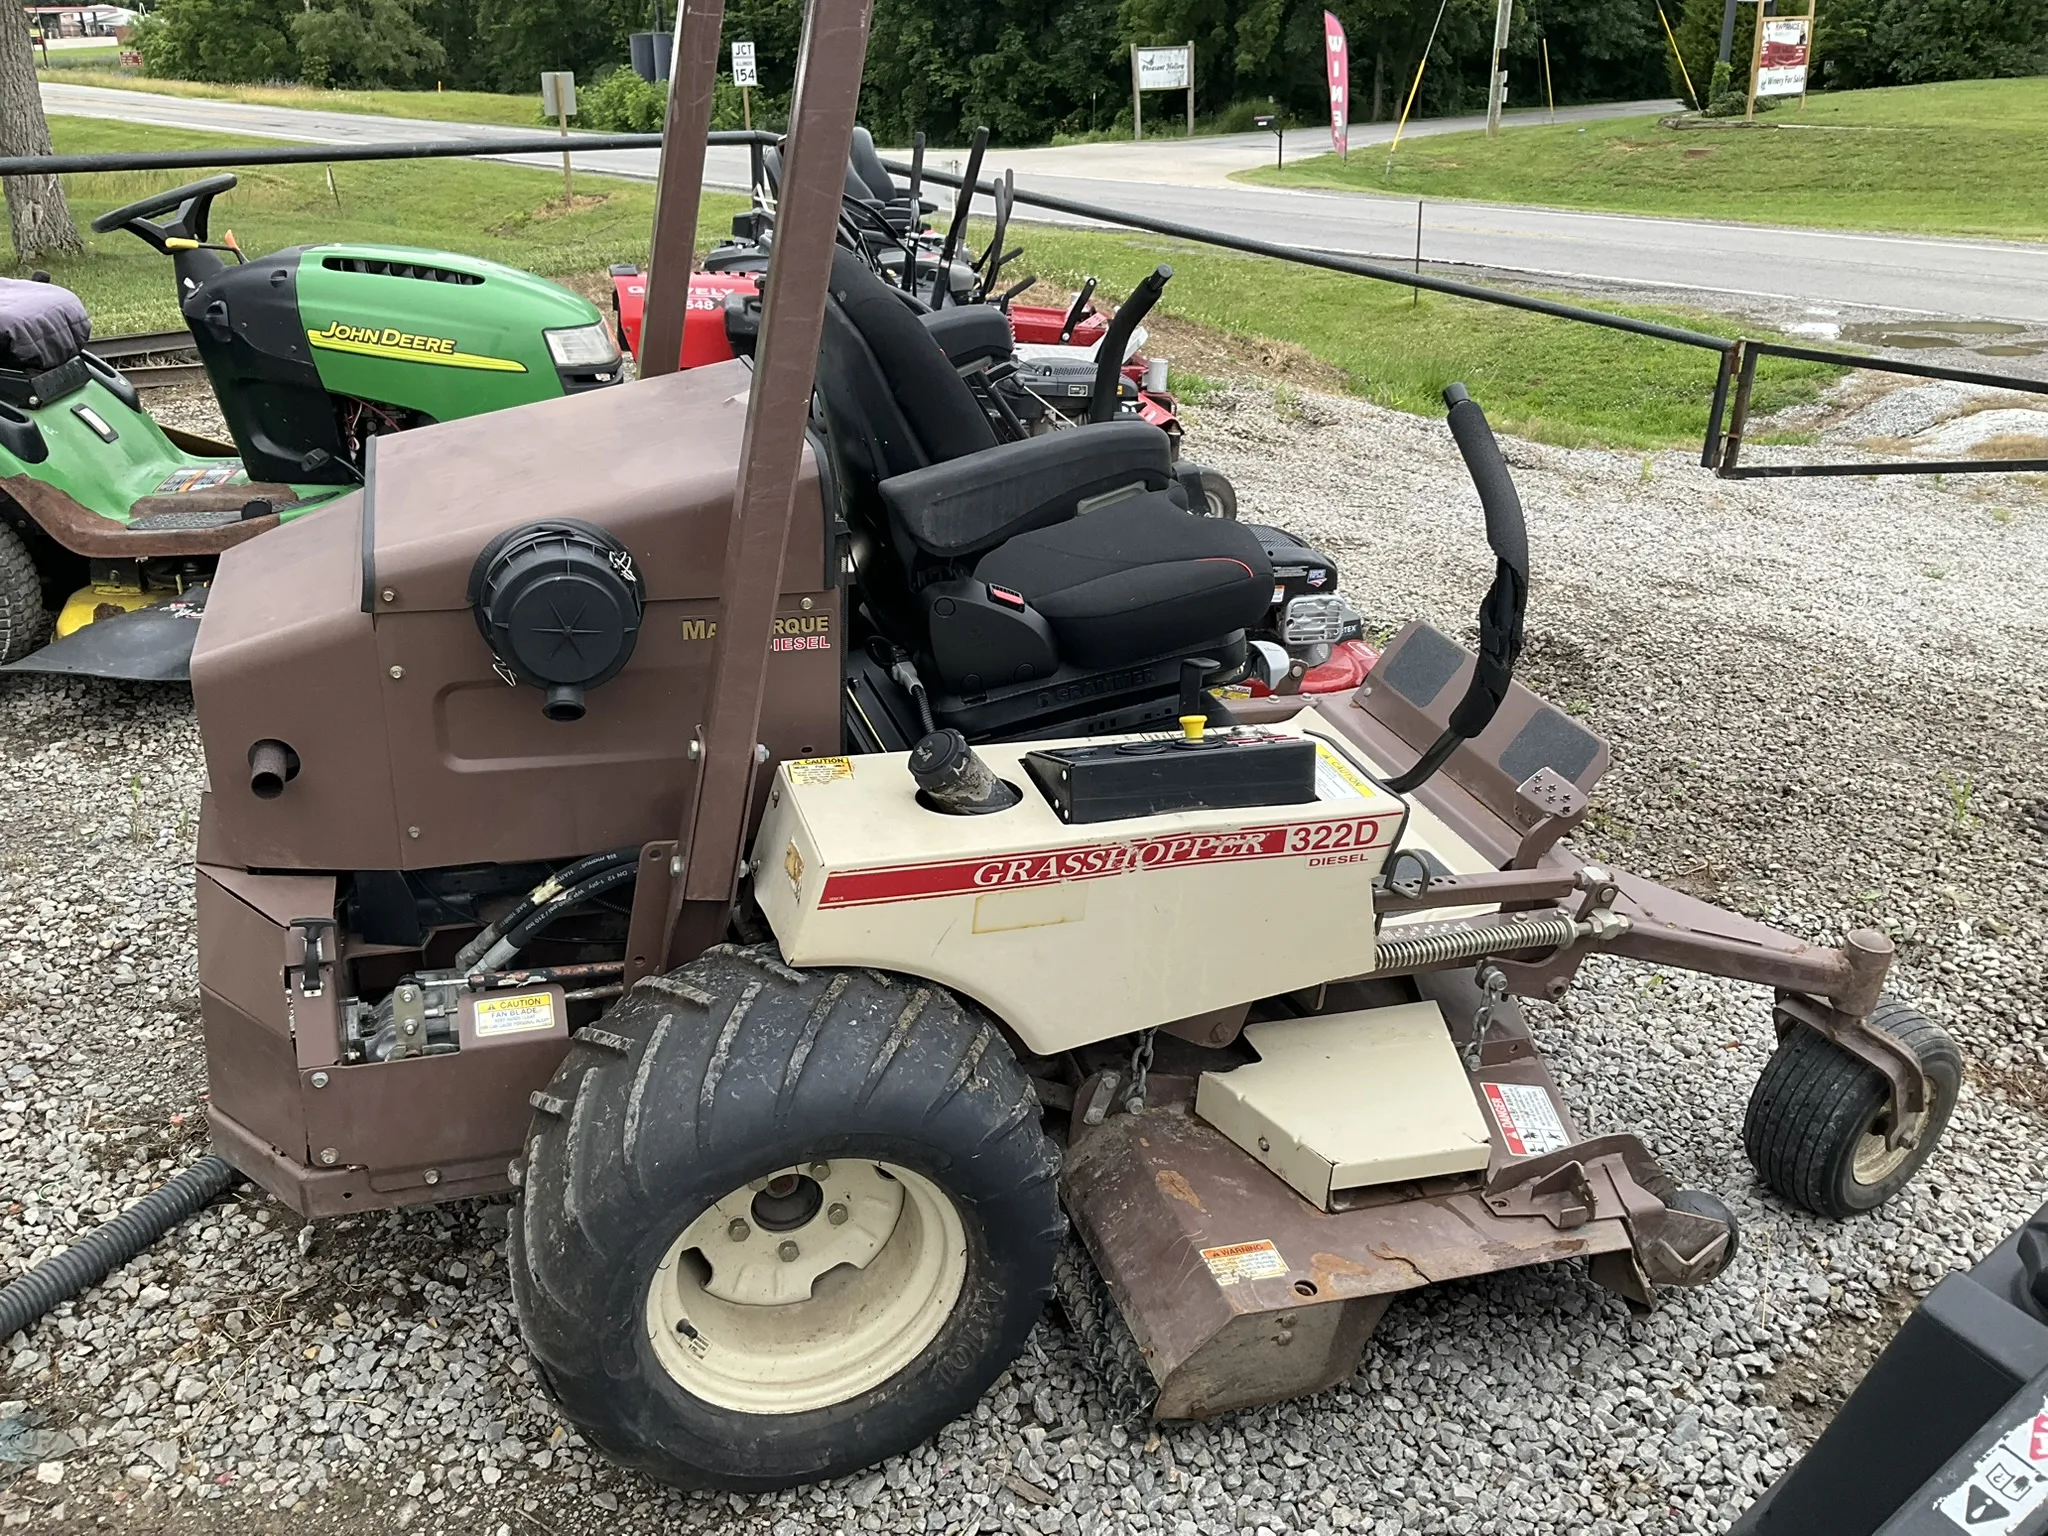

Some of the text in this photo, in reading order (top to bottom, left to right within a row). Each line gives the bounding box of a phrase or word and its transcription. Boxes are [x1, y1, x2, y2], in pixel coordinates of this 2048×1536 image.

[735, 44, 752, 56] JCT
[735, 68, 755, 82] 154
[1328, 35, 1343, 127] WINE
[1767, 75, 1804, 86] Winery For Sale
[320, 320, 456, 354] JOHN DEERE
[770, 635, 831, 651] IESEL
[804, 757, 844, 765] CAUTION
[1331, 761, 1363, 787] CAUTION
[973, 820, 1379, 886] GRASSHOPPER 322D
[1309, 853, 1369, 867] DIESEL
[499, 997, 541, 1009] CAUTION
[509, 1007, 537, 1017] BLADE
[1491, 1097, 1515, 1128] DANGER
[1221, 1244, 1264, 1256] WARNING
